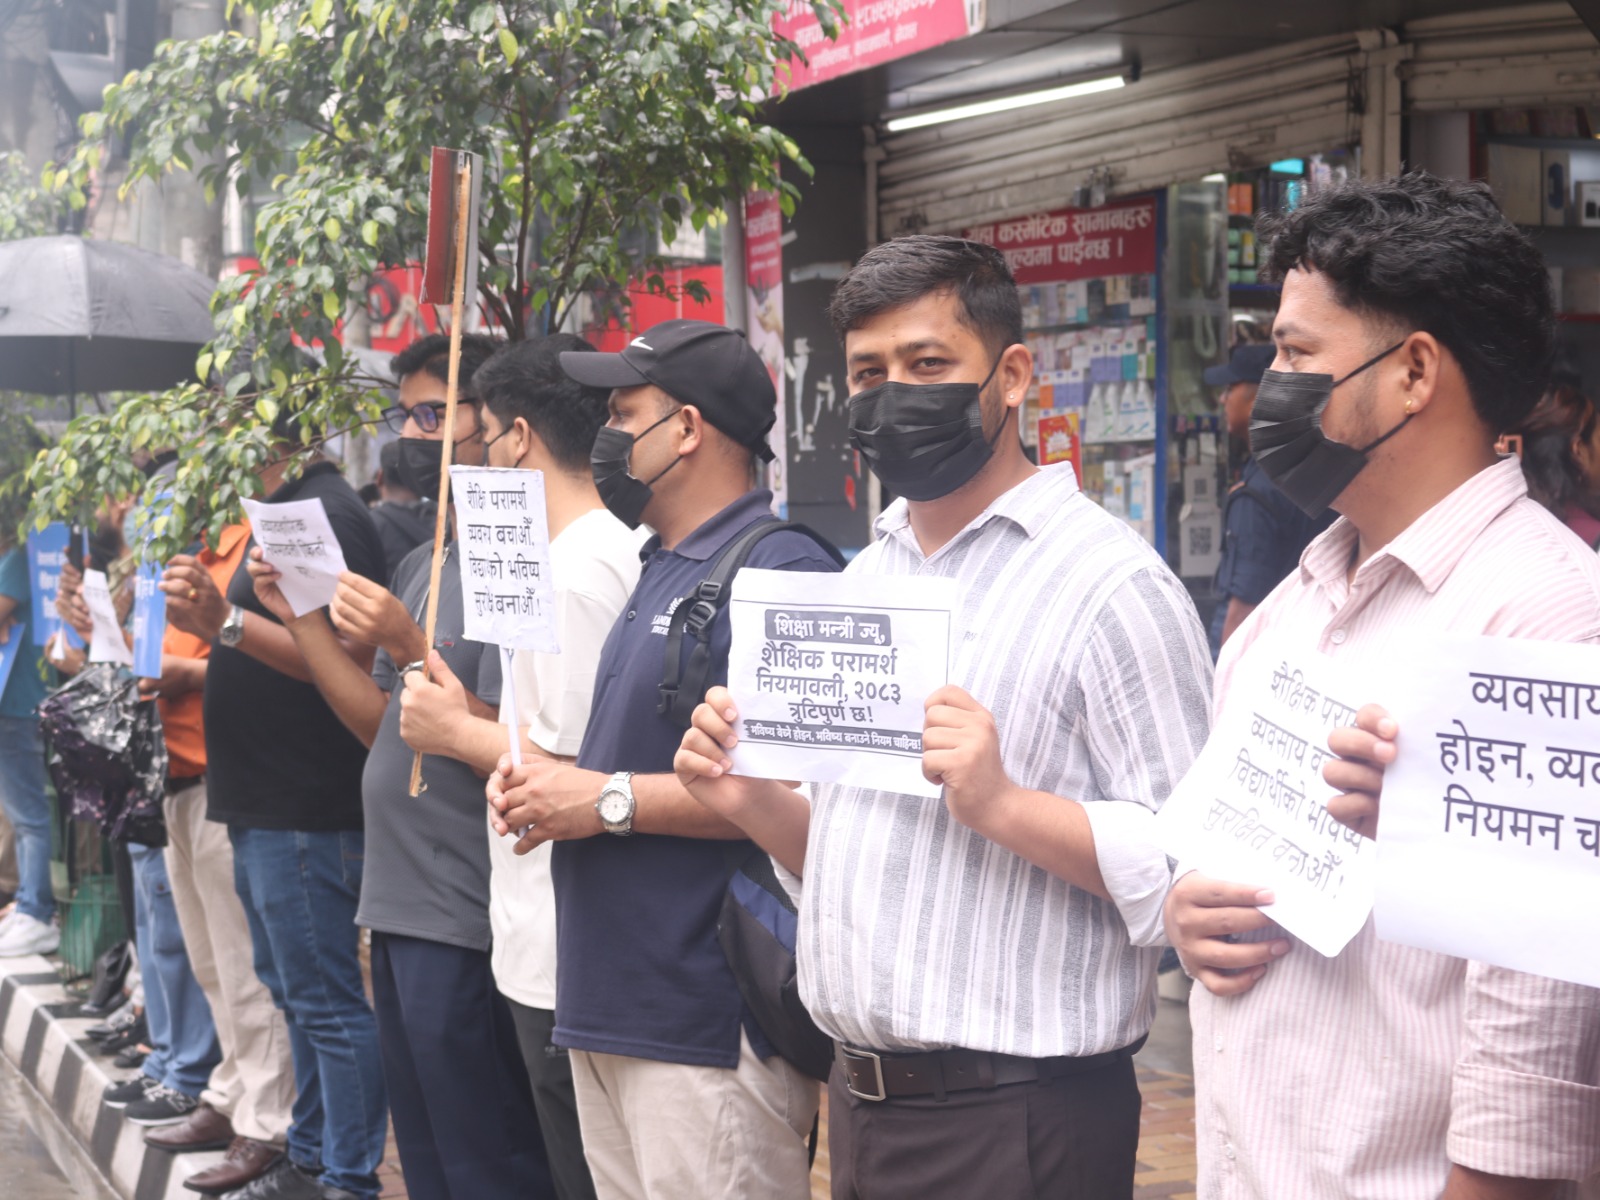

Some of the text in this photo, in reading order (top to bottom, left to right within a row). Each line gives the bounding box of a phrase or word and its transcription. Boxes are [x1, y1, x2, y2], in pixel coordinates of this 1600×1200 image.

[489, 482, 527, 510] परामर्श
[508, 552, 540, 581] भविष्य
[774, 612, 886, 645] शिक्षा मन्त्री ज्यू,
[761, 640, 898, 675] शैक्षिक परामर्श
[756, 667, 901, 705] नियमावली, २०८३
[1271, 661, 1320, 712] शैक्षिक
[850, 704, 874, 723] छ!
[750, 723, 775, 737] भविष्य
[793, 726, 815, 743] होइन,
[816, 728, 842, 743] भविष्य
[871, 731, 892, 746] नियम
[1251, 712, 1309, 768] व्यवसाय
[1436, 719, 1534, 788] होइन,
[1228, 747, 1306, 821] विद्यार्थीको
[1203, 798, 1276, 851] सुरक्षित
[1443, 783, 1564, 851] नियमन
